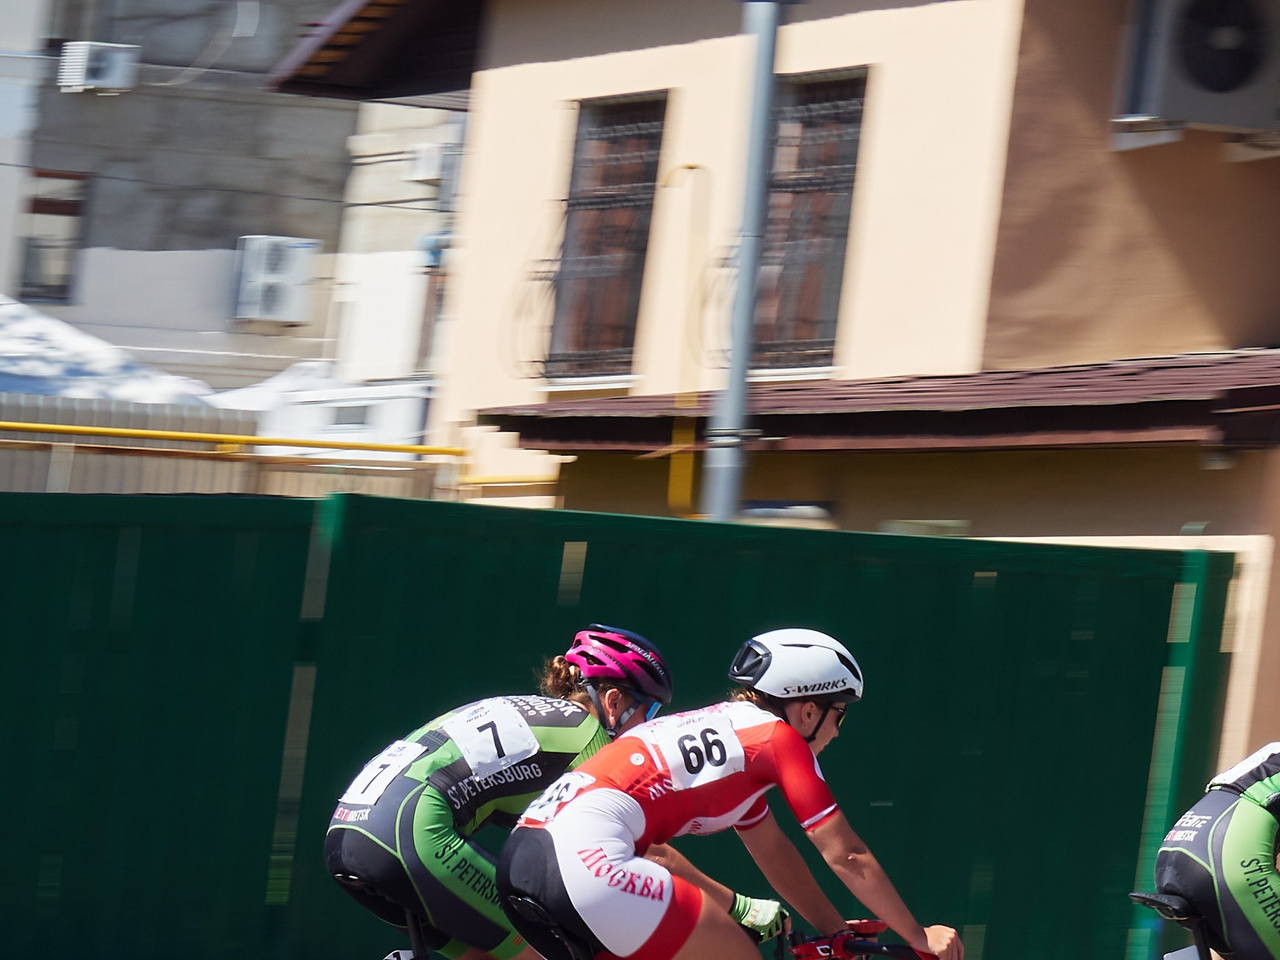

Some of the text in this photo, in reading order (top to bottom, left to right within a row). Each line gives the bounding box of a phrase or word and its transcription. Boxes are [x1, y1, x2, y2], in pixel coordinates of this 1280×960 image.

[780, 677, 849, 696] S-WORKS
[476, 720, 507, 759] 7
[677, 727, 727, 775] 66
[360, 763, 391, 794] 7
[447, 762, 543, 811] ST.PETERSBURG
[577, 846, 665, 902] МОСКВА
